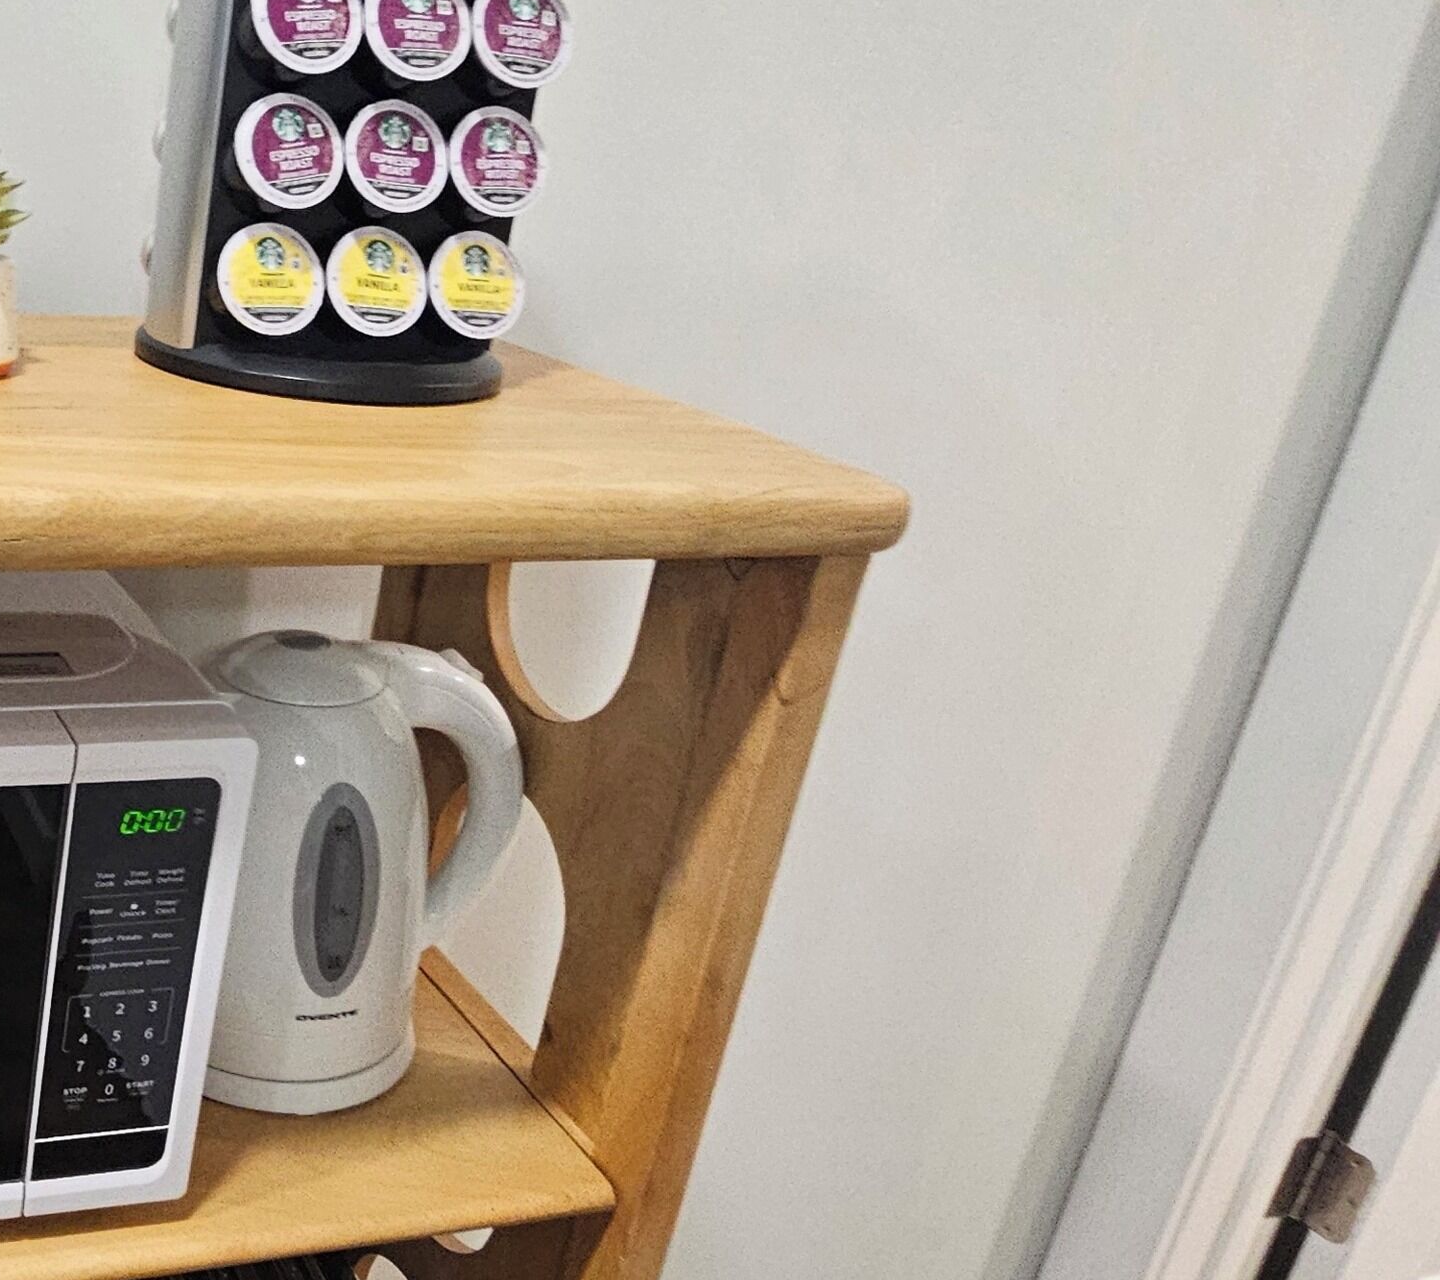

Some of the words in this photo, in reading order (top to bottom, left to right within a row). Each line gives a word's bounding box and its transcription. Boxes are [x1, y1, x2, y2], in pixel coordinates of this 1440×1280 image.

[120, 809, 186, 834] 0:00
[83, 1006, 91, 1018] 1
[115, 1003, 125, 1015] 2
[148, 1000, 158, 1013] 3
[78, 1033, 88, 1045] 4
[112, 1030, 121, 1042] 5
[144, 1027, 154, 1040] 6
[107, 1057, 117, 1069] 8
[141, 1054, 150, 1066] 9
[76, 1060, 85, 1073] 7
[104, 1083, 114, 1096] 0
[125, 1080, 154, 1089] START
[63, 1086, 88, 1096] STOP
